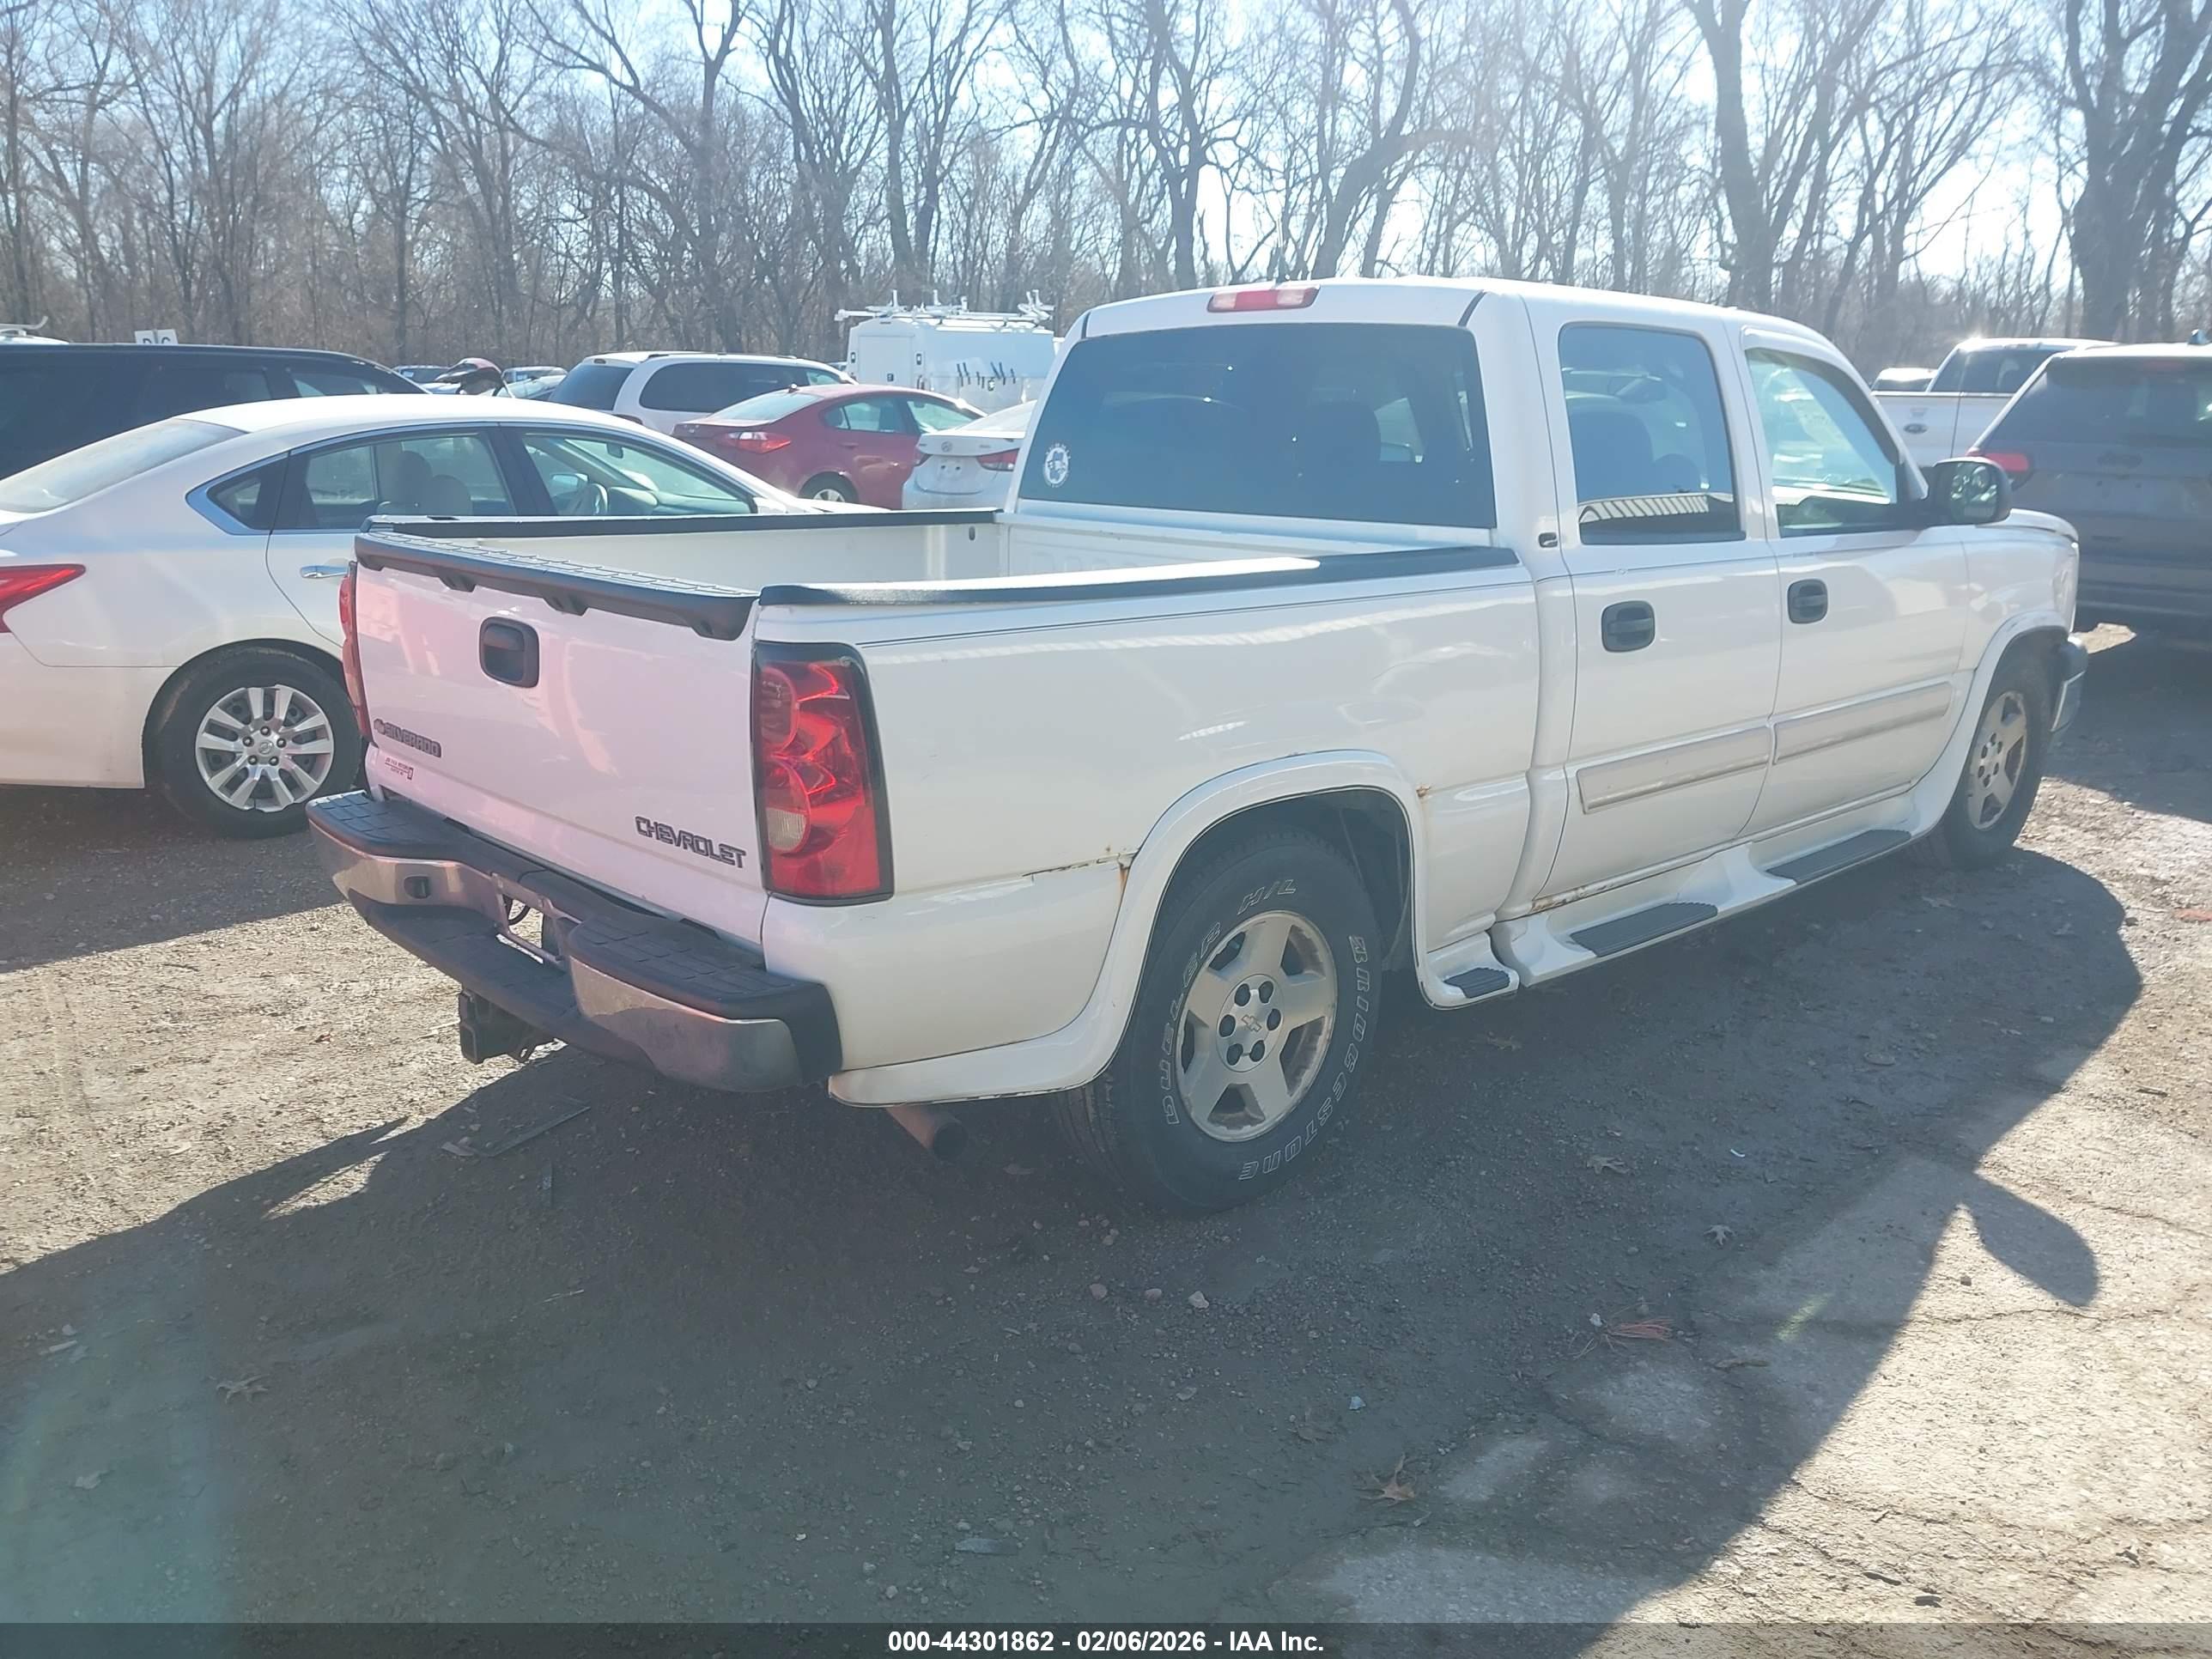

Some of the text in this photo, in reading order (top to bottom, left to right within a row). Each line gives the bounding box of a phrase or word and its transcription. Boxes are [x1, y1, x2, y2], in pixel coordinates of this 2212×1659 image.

[385, 723, 441, 758] SILVERADO
[635, 817, 746, 868] CHEVROLET
[1160, 878, 1297, 1125] DUELER H/L
[1238, 934, 1370, 1180] BRIDGESTONE
